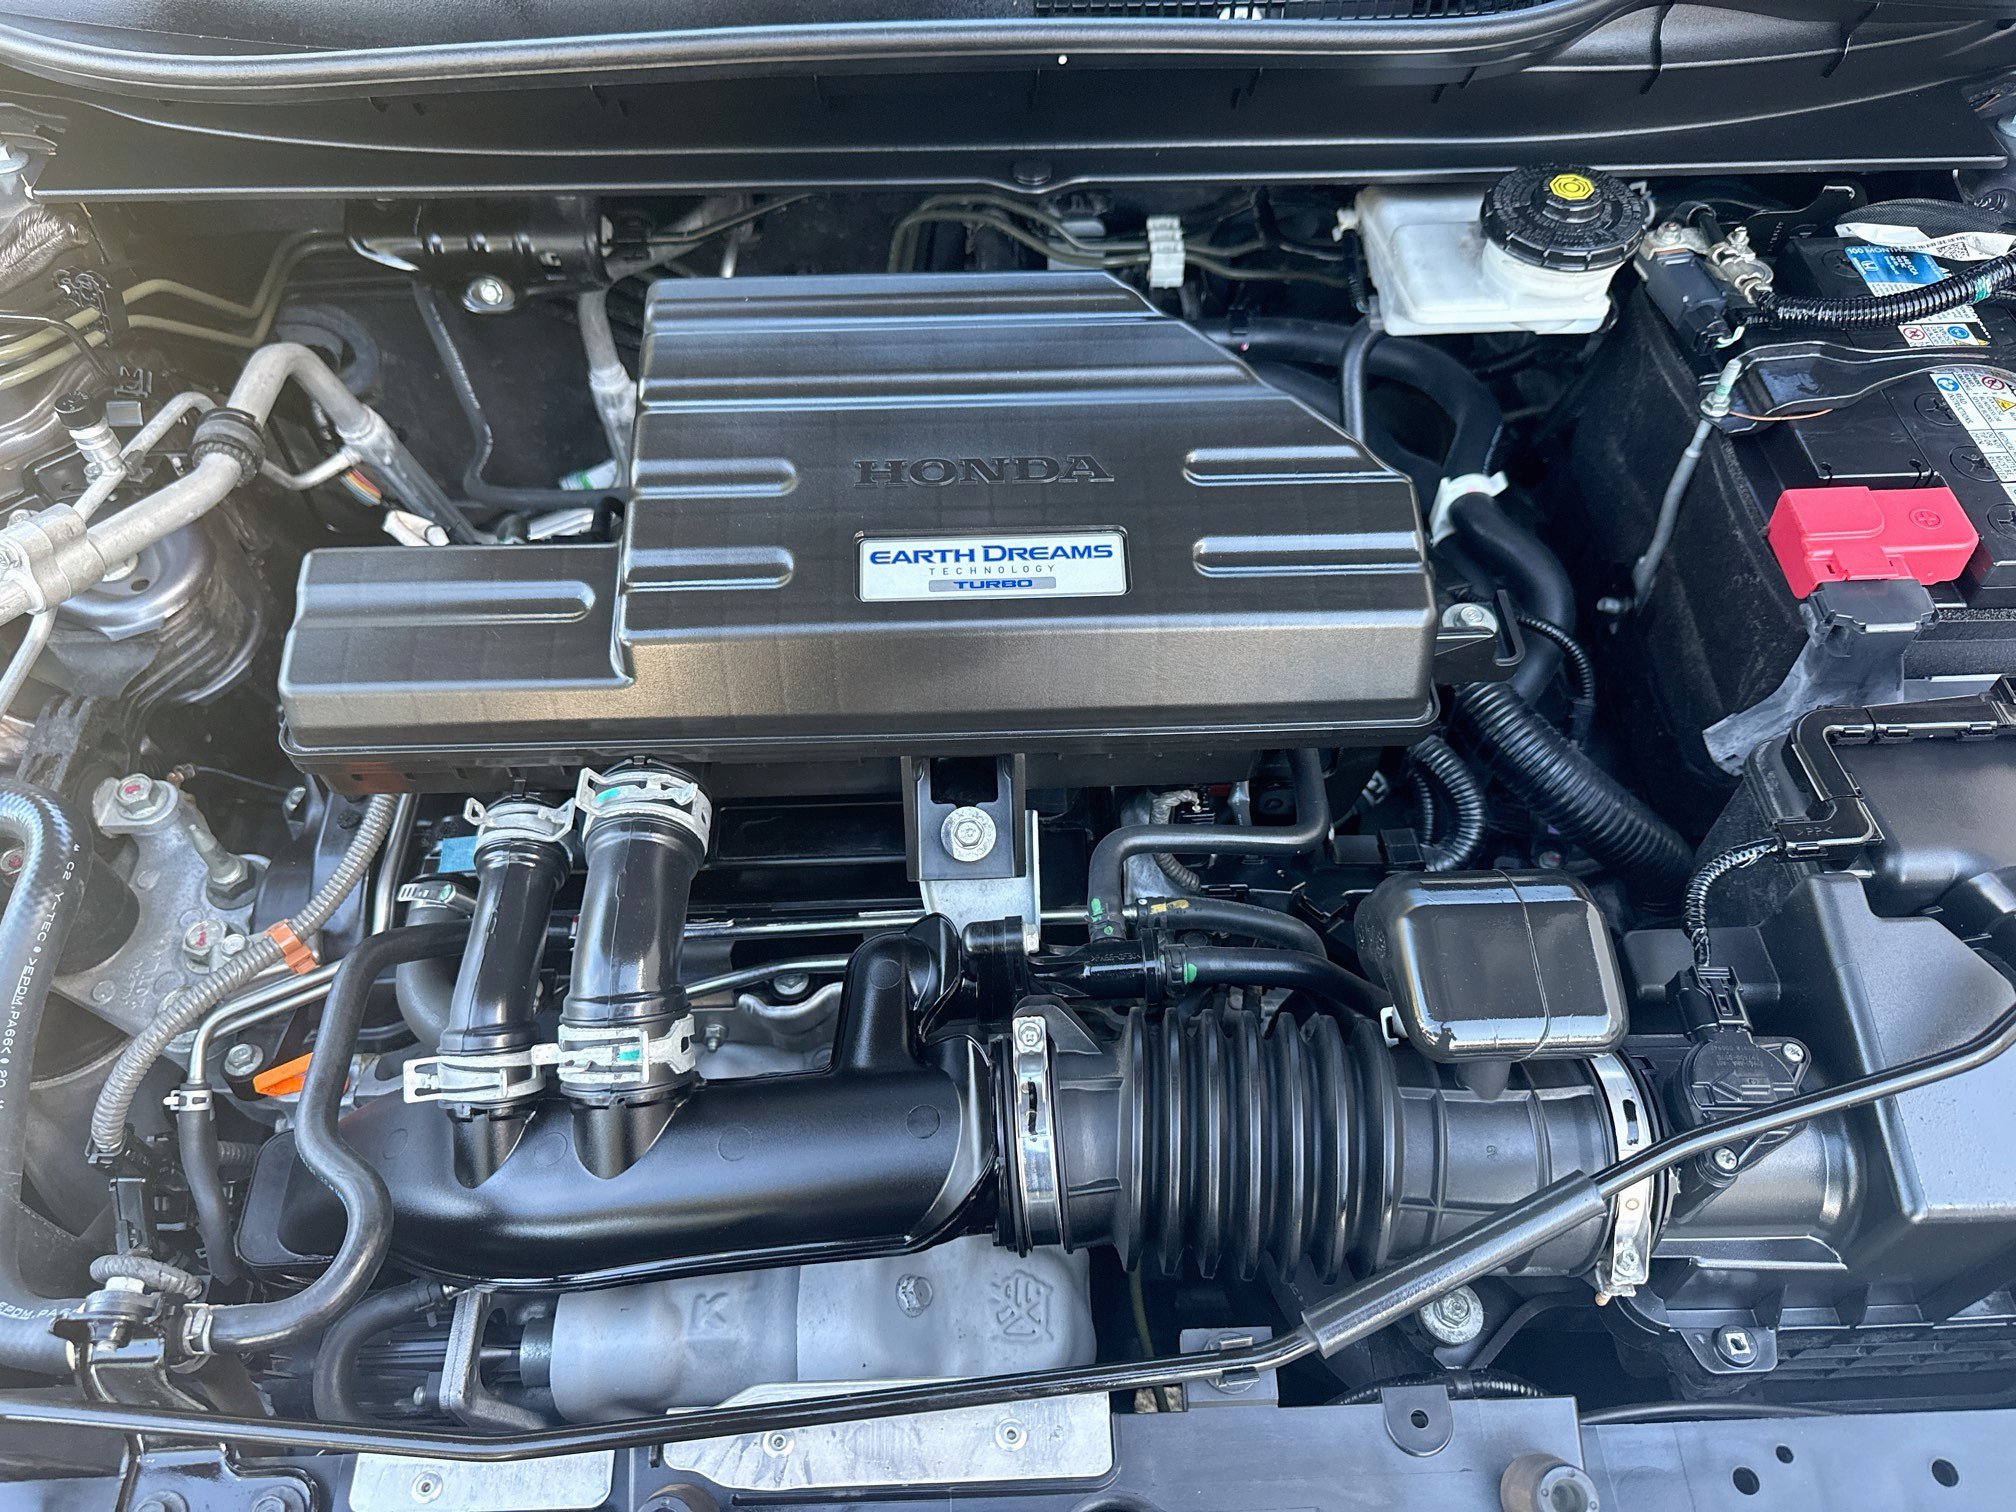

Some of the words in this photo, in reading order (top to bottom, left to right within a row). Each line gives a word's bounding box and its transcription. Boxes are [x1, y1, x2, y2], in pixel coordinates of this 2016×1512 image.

[854, 455, 1115, 488] HONDA
[870, 548, 976, 565] EARTH
[982, 544, 1113, 562] DREAMS
[929, 564, 1055, 576] TECHNOLOGY
[953, 578, 1033, 590] TURBO
[63, 861, 75, 881] C2
[37, 892, 64, 942] Y-TEC
